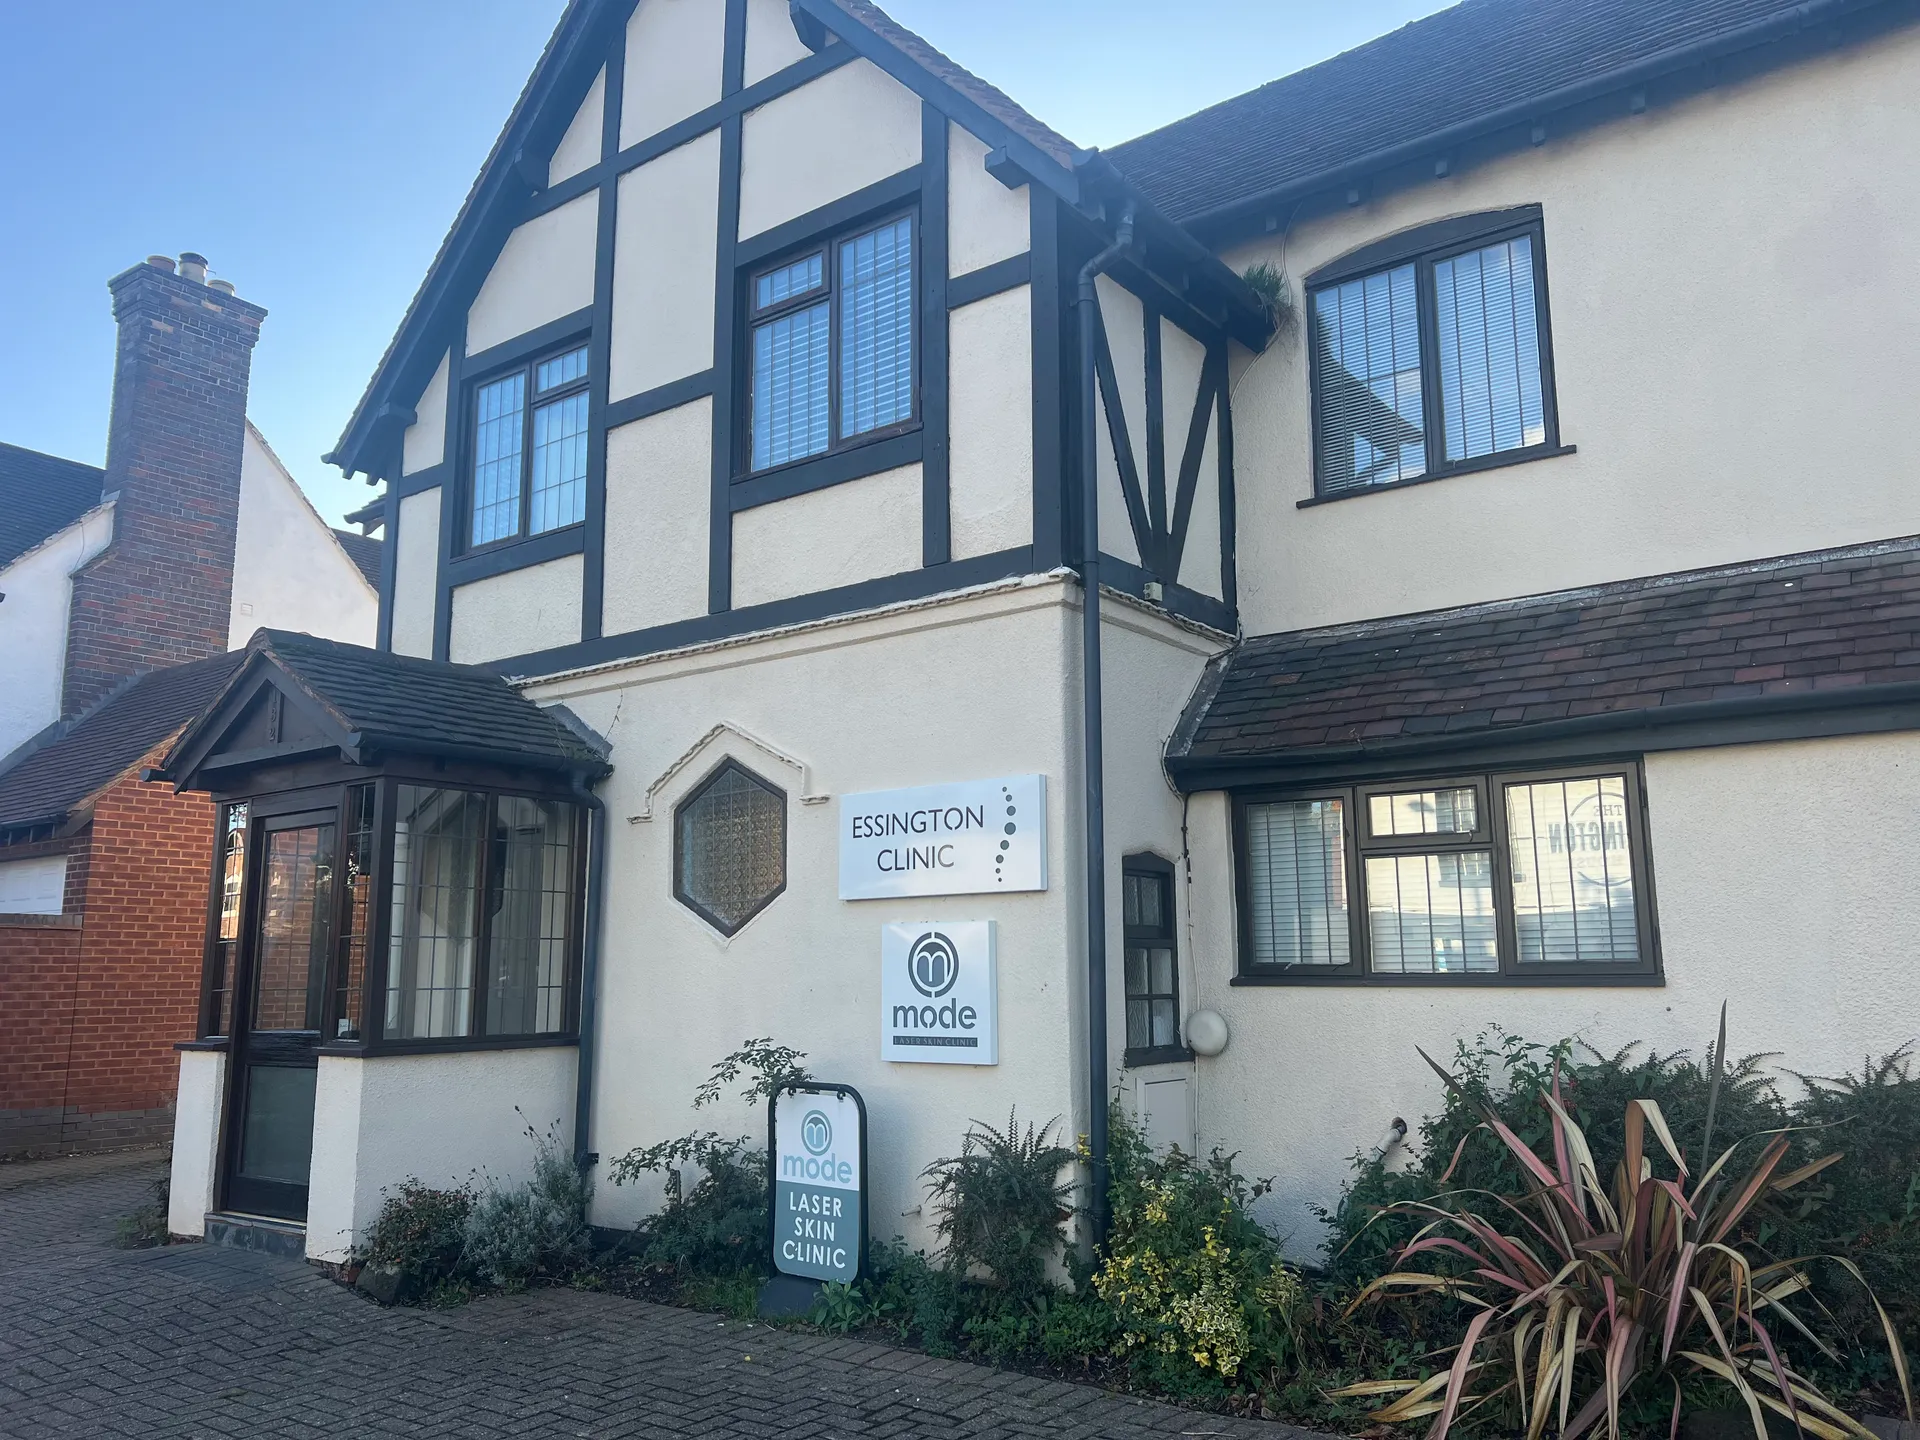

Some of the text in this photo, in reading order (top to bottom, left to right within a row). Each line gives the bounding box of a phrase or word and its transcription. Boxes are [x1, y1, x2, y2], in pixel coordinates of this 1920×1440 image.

[852, 804, 984, 839] ESSINGTON
[877, 844, 955, 872] CLINIC
[893, 998, 977, 1030] mode
[894, 1036, 977, 1046] LASER SKIN CLINIC
[783, 1152, 852, 1184] mode
[790, 1191, 842, 1218] LASER
[794, 1216, 835, 1242] SKIN
[782, 1239, 846, 1269] CLINIC
